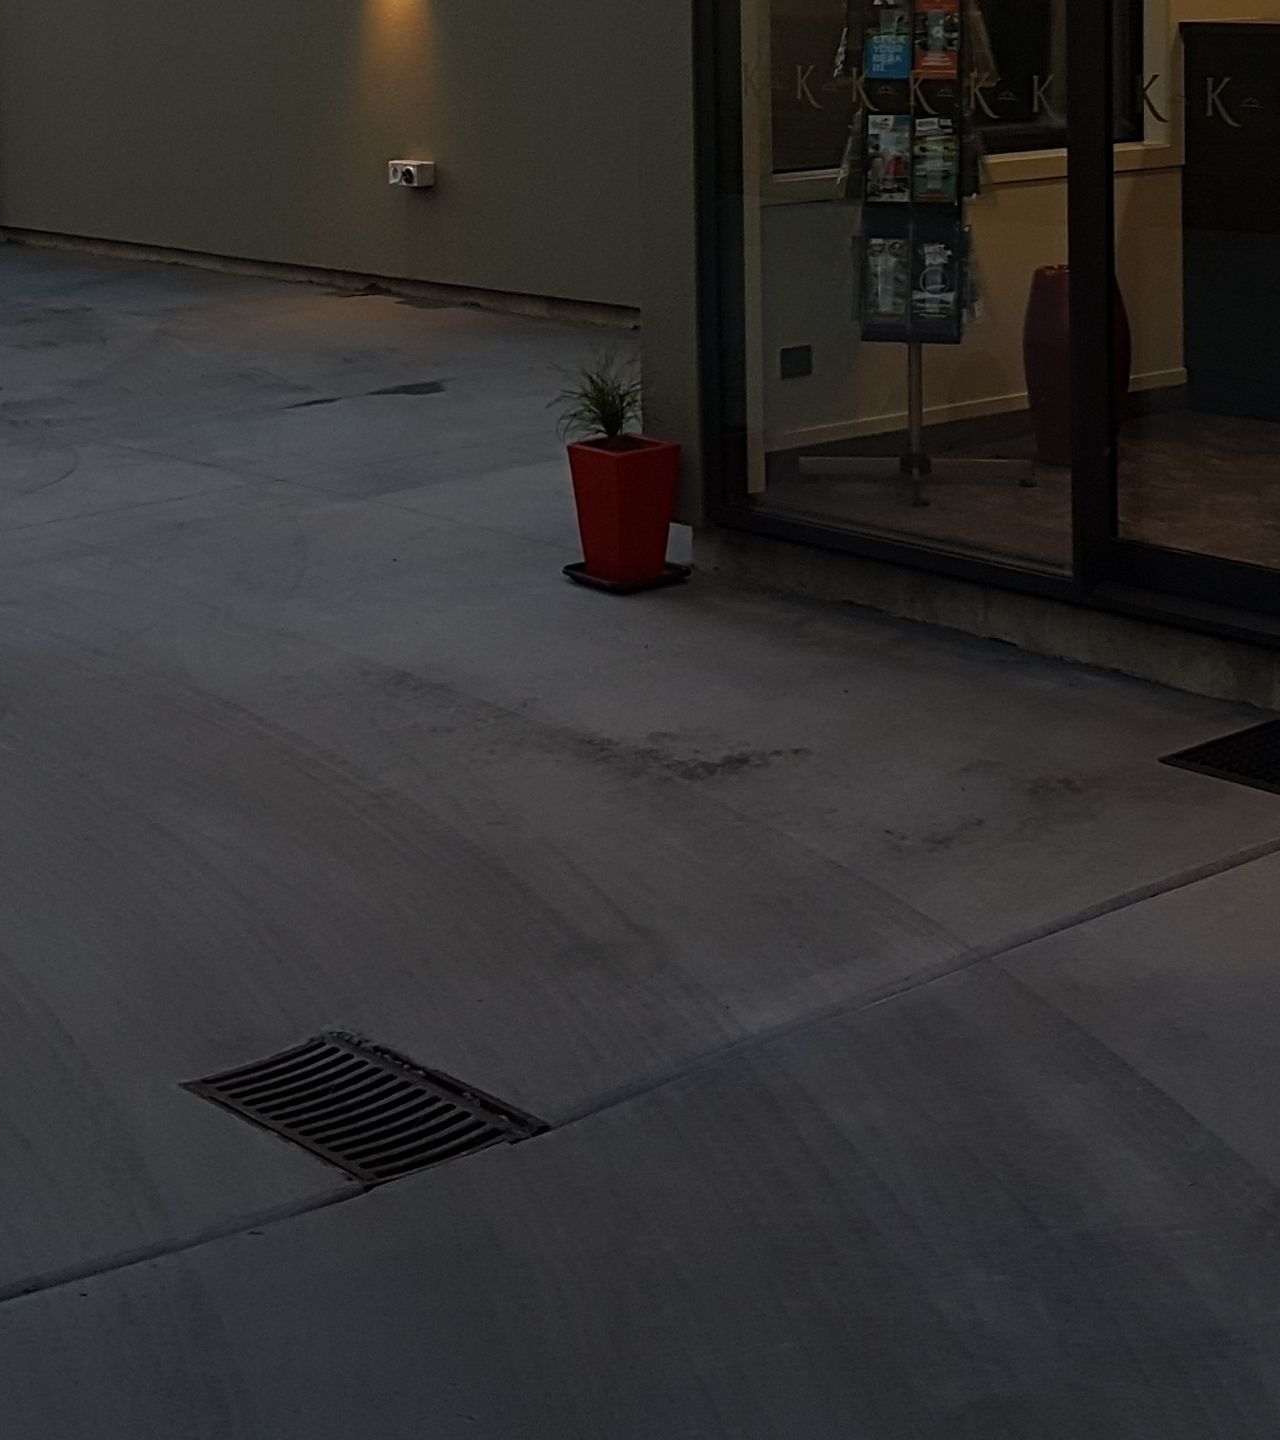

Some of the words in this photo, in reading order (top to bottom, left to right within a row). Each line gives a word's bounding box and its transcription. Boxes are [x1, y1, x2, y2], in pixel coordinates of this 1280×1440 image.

[796, 65, 823, 109] K
[851, 66, 879, 111] K
[910, 69, 940, 115] K
[969, 71, 1001, 119] K
[1032, 73, 1061, 123] K
[1136, 74, 1169, 123] K
[1205, 76, 1242, 128] K
